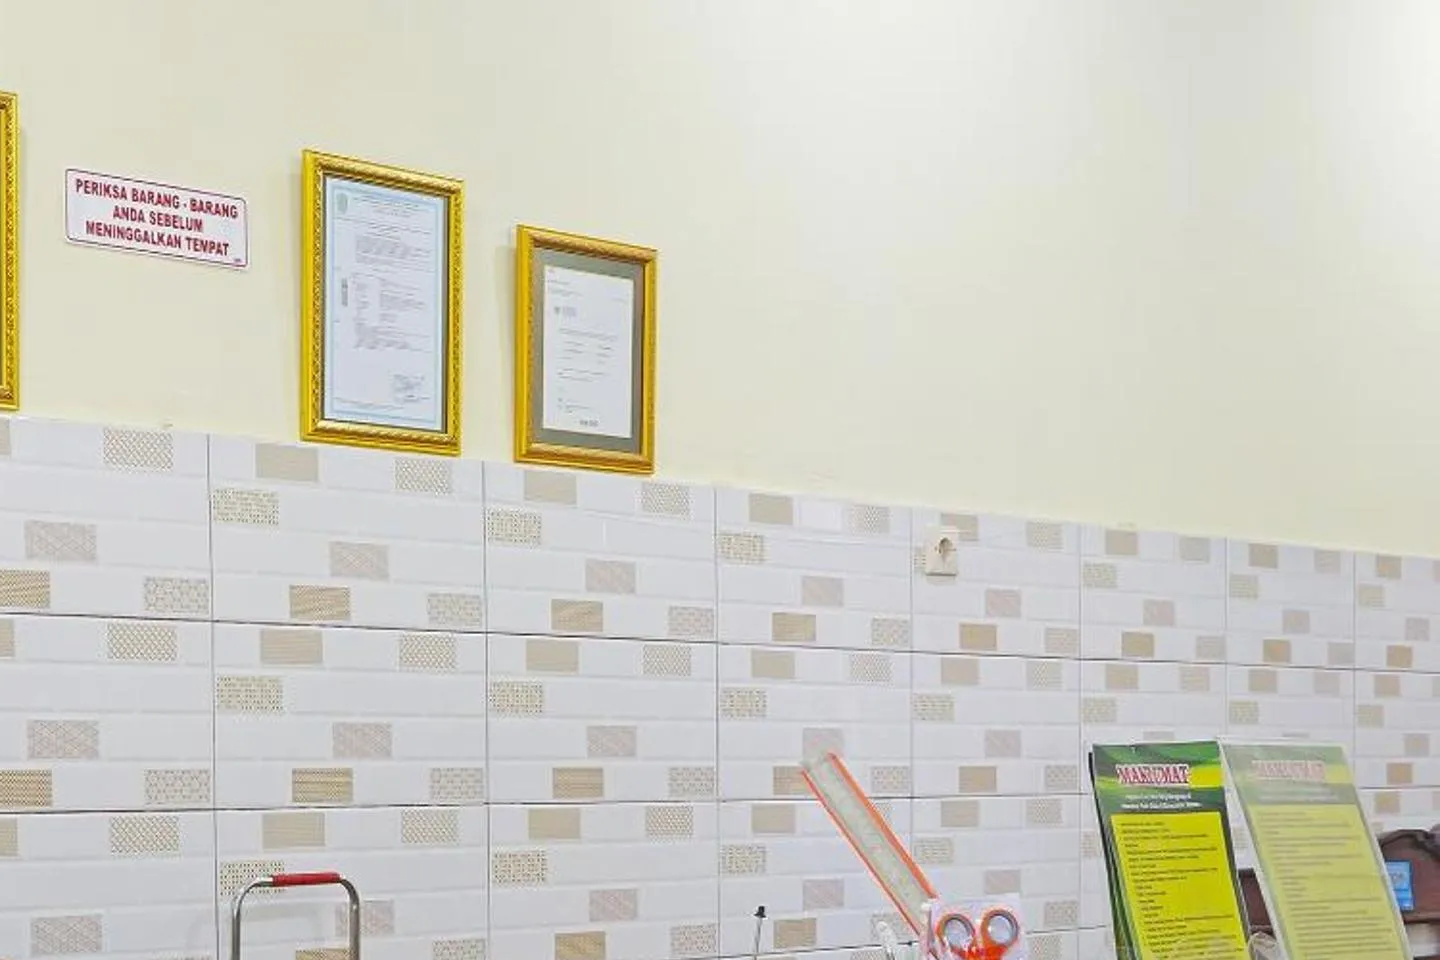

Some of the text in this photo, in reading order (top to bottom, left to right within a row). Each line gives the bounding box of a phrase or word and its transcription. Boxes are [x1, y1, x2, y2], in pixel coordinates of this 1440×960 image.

[75, 178, 127, 201] PERIKSA
[131, 188, 180, 209] BARANG
[190, 199, 238, 219] BARANG
[113, 206, 204, 232] ANDA SEBELUM
[85, 220, 229, 256] MENINGGALKAN TEMPAT
